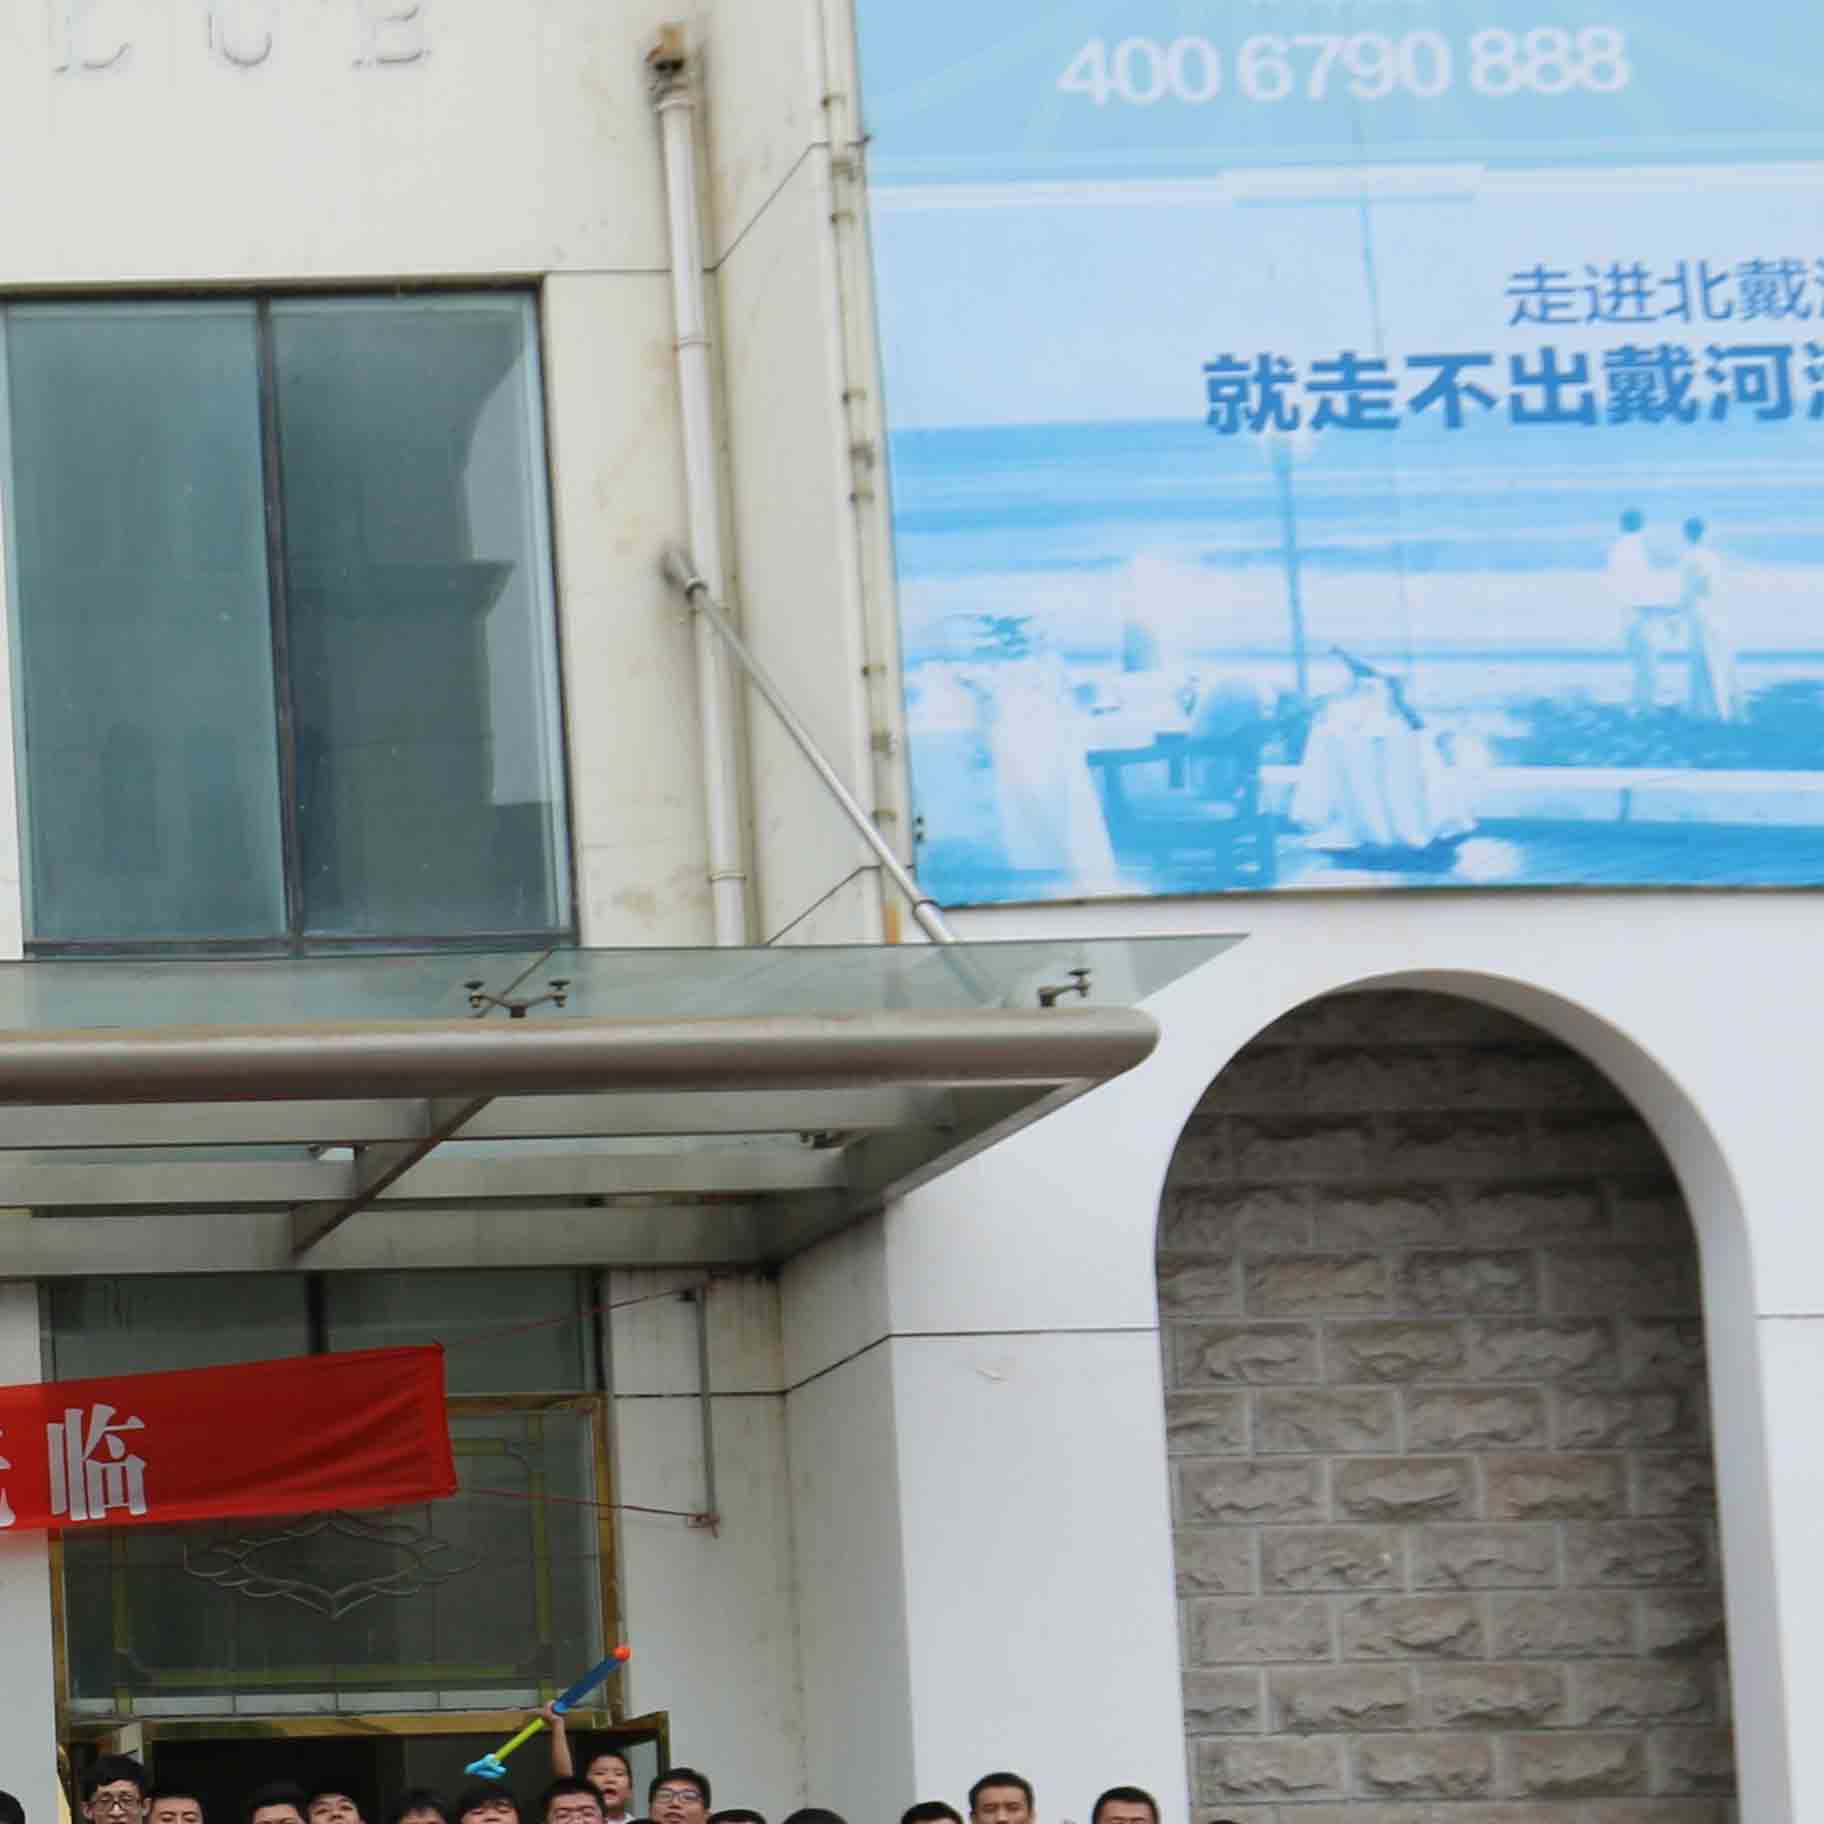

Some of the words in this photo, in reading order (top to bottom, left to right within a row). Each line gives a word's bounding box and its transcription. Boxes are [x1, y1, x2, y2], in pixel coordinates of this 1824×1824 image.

[1056, 36, 1222, 106] 400
[1238, 30, 1454, 101] 6790
[1470, 25, 1632, 96] 888
